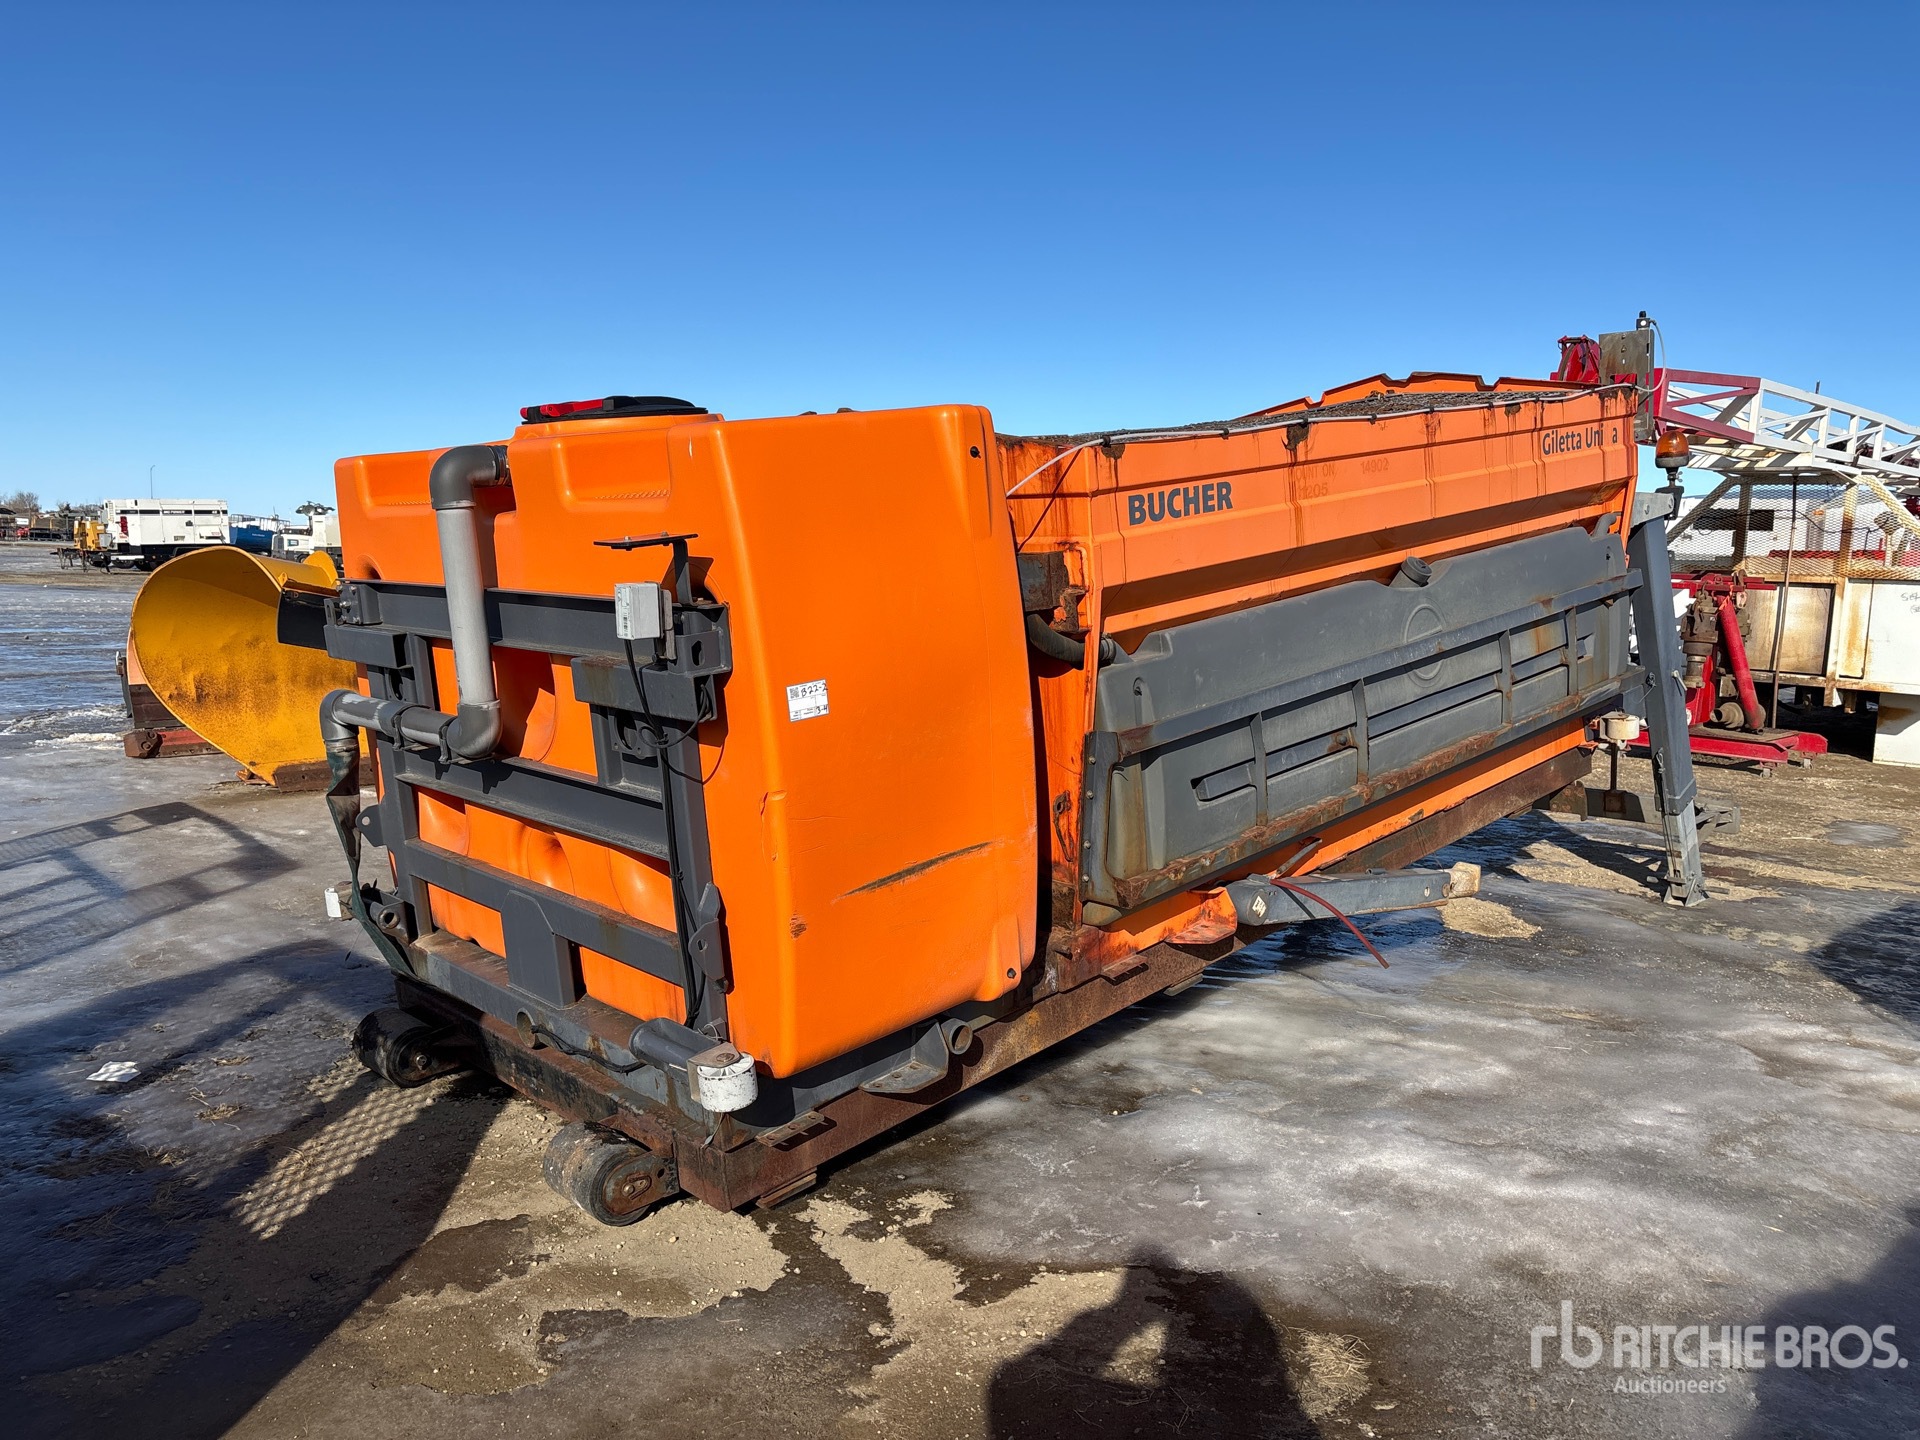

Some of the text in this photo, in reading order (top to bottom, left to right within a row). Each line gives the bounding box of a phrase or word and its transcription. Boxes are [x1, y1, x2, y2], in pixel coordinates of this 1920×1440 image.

[1542, 429, 1582, 455] Giletta
[1360, 457, 1390, 475] 14902
[1127, 481, 1234, 527] BUCHER
